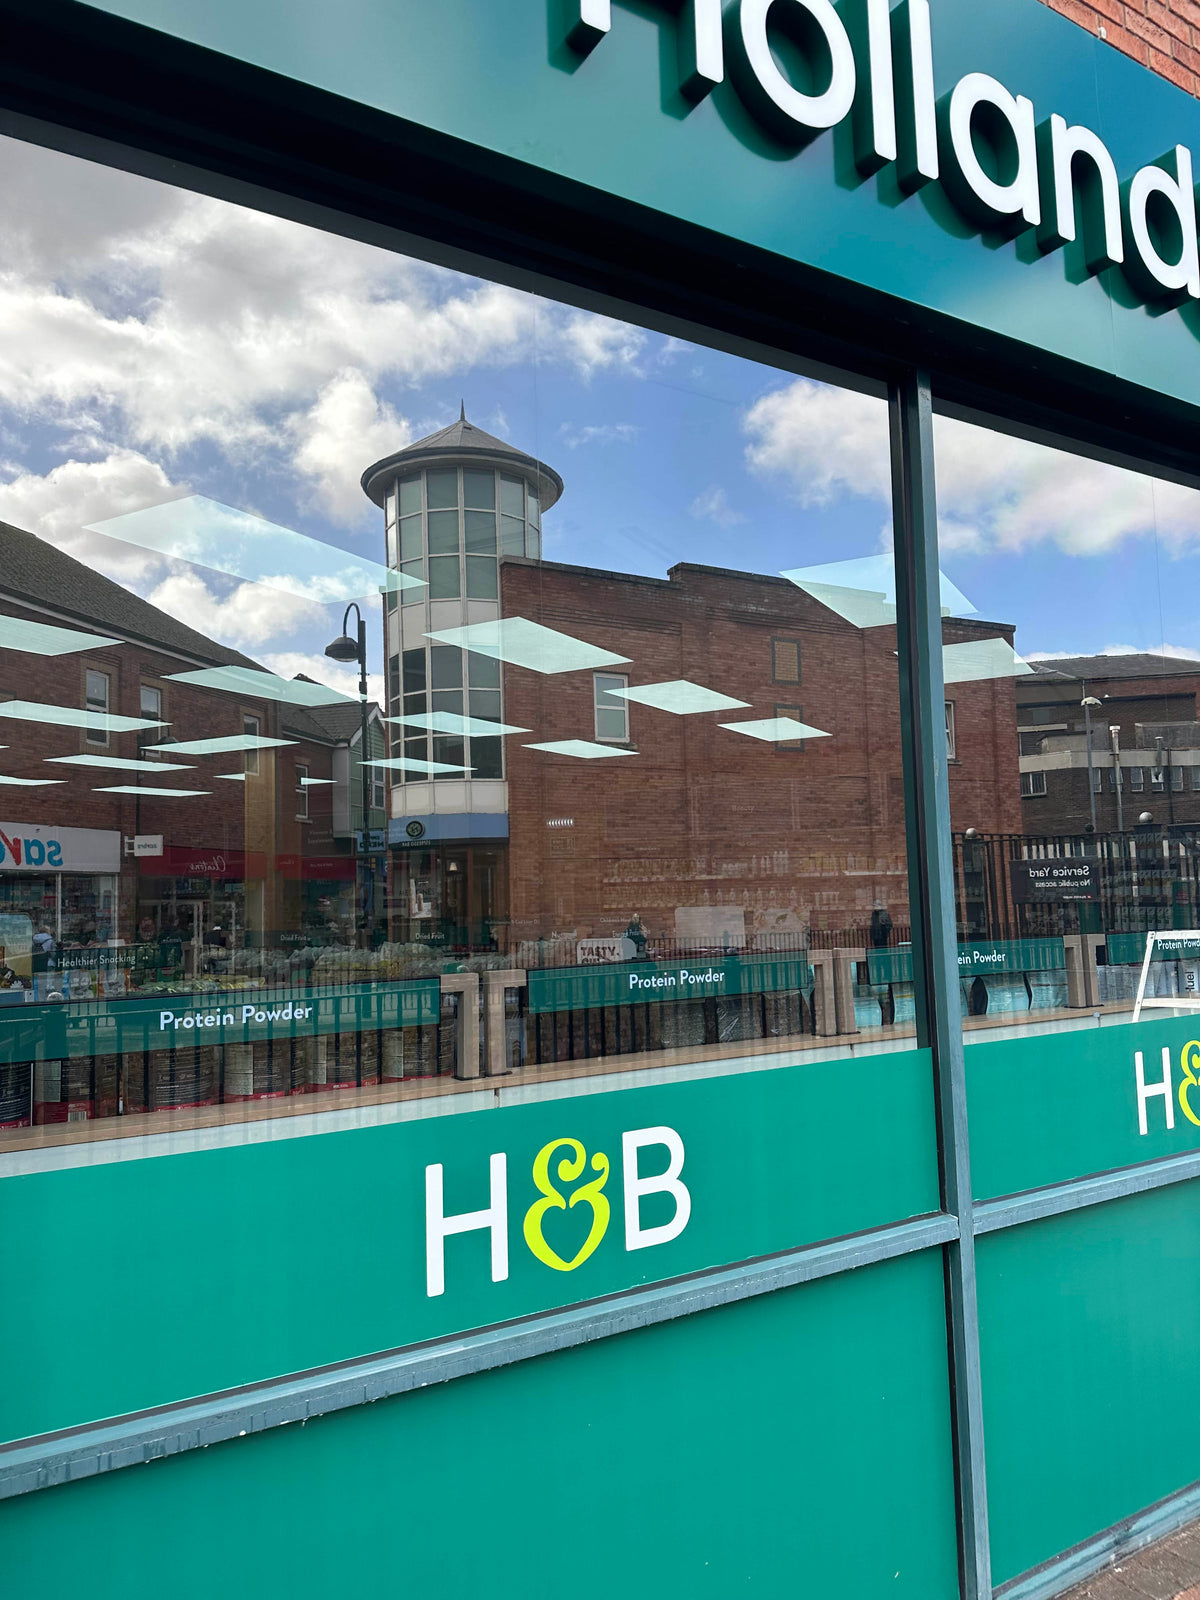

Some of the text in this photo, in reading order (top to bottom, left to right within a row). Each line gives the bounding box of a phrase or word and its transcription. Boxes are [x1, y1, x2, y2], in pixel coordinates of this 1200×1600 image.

[415, 932, 445, 940] Dried Fruit
[1157, 938, 1182, 950] Protein
[57, 954, 136, 968] Healthier Snacking
[973, 949, 1006, 964] Powder
[629, 968, 725, 989] Protein Powder
[160, 1002, 313, 1030] Protein Powder
[425, 1126, 691, 1298] H&B
